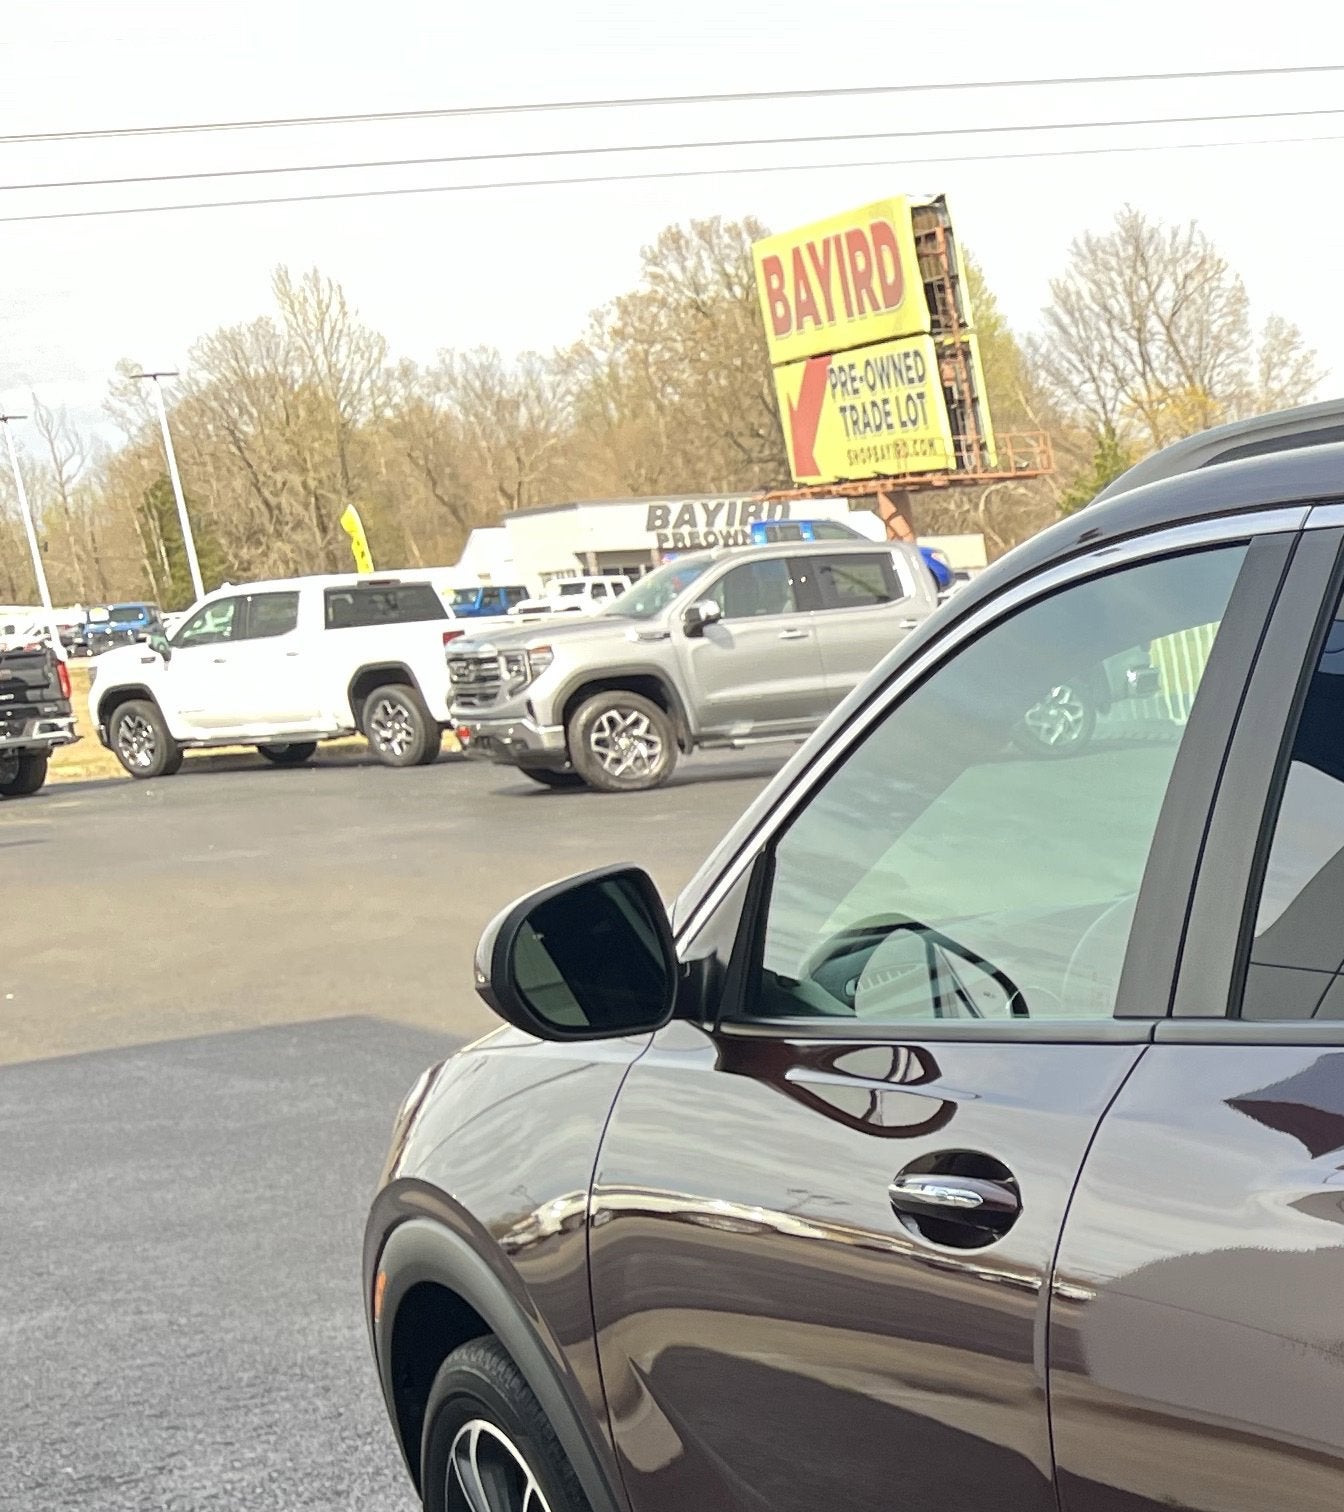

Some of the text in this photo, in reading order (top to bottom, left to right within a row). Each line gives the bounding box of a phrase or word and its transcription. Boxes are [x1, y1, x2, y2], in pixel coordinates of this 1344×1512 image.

[761, 219, 905, 337] BAYIRD
[828, 350, 926, 398] PRE-OWNED
[840, 393, 928, 437] TRADE LOT
[646, 501, 791, 531] BAYIRD
